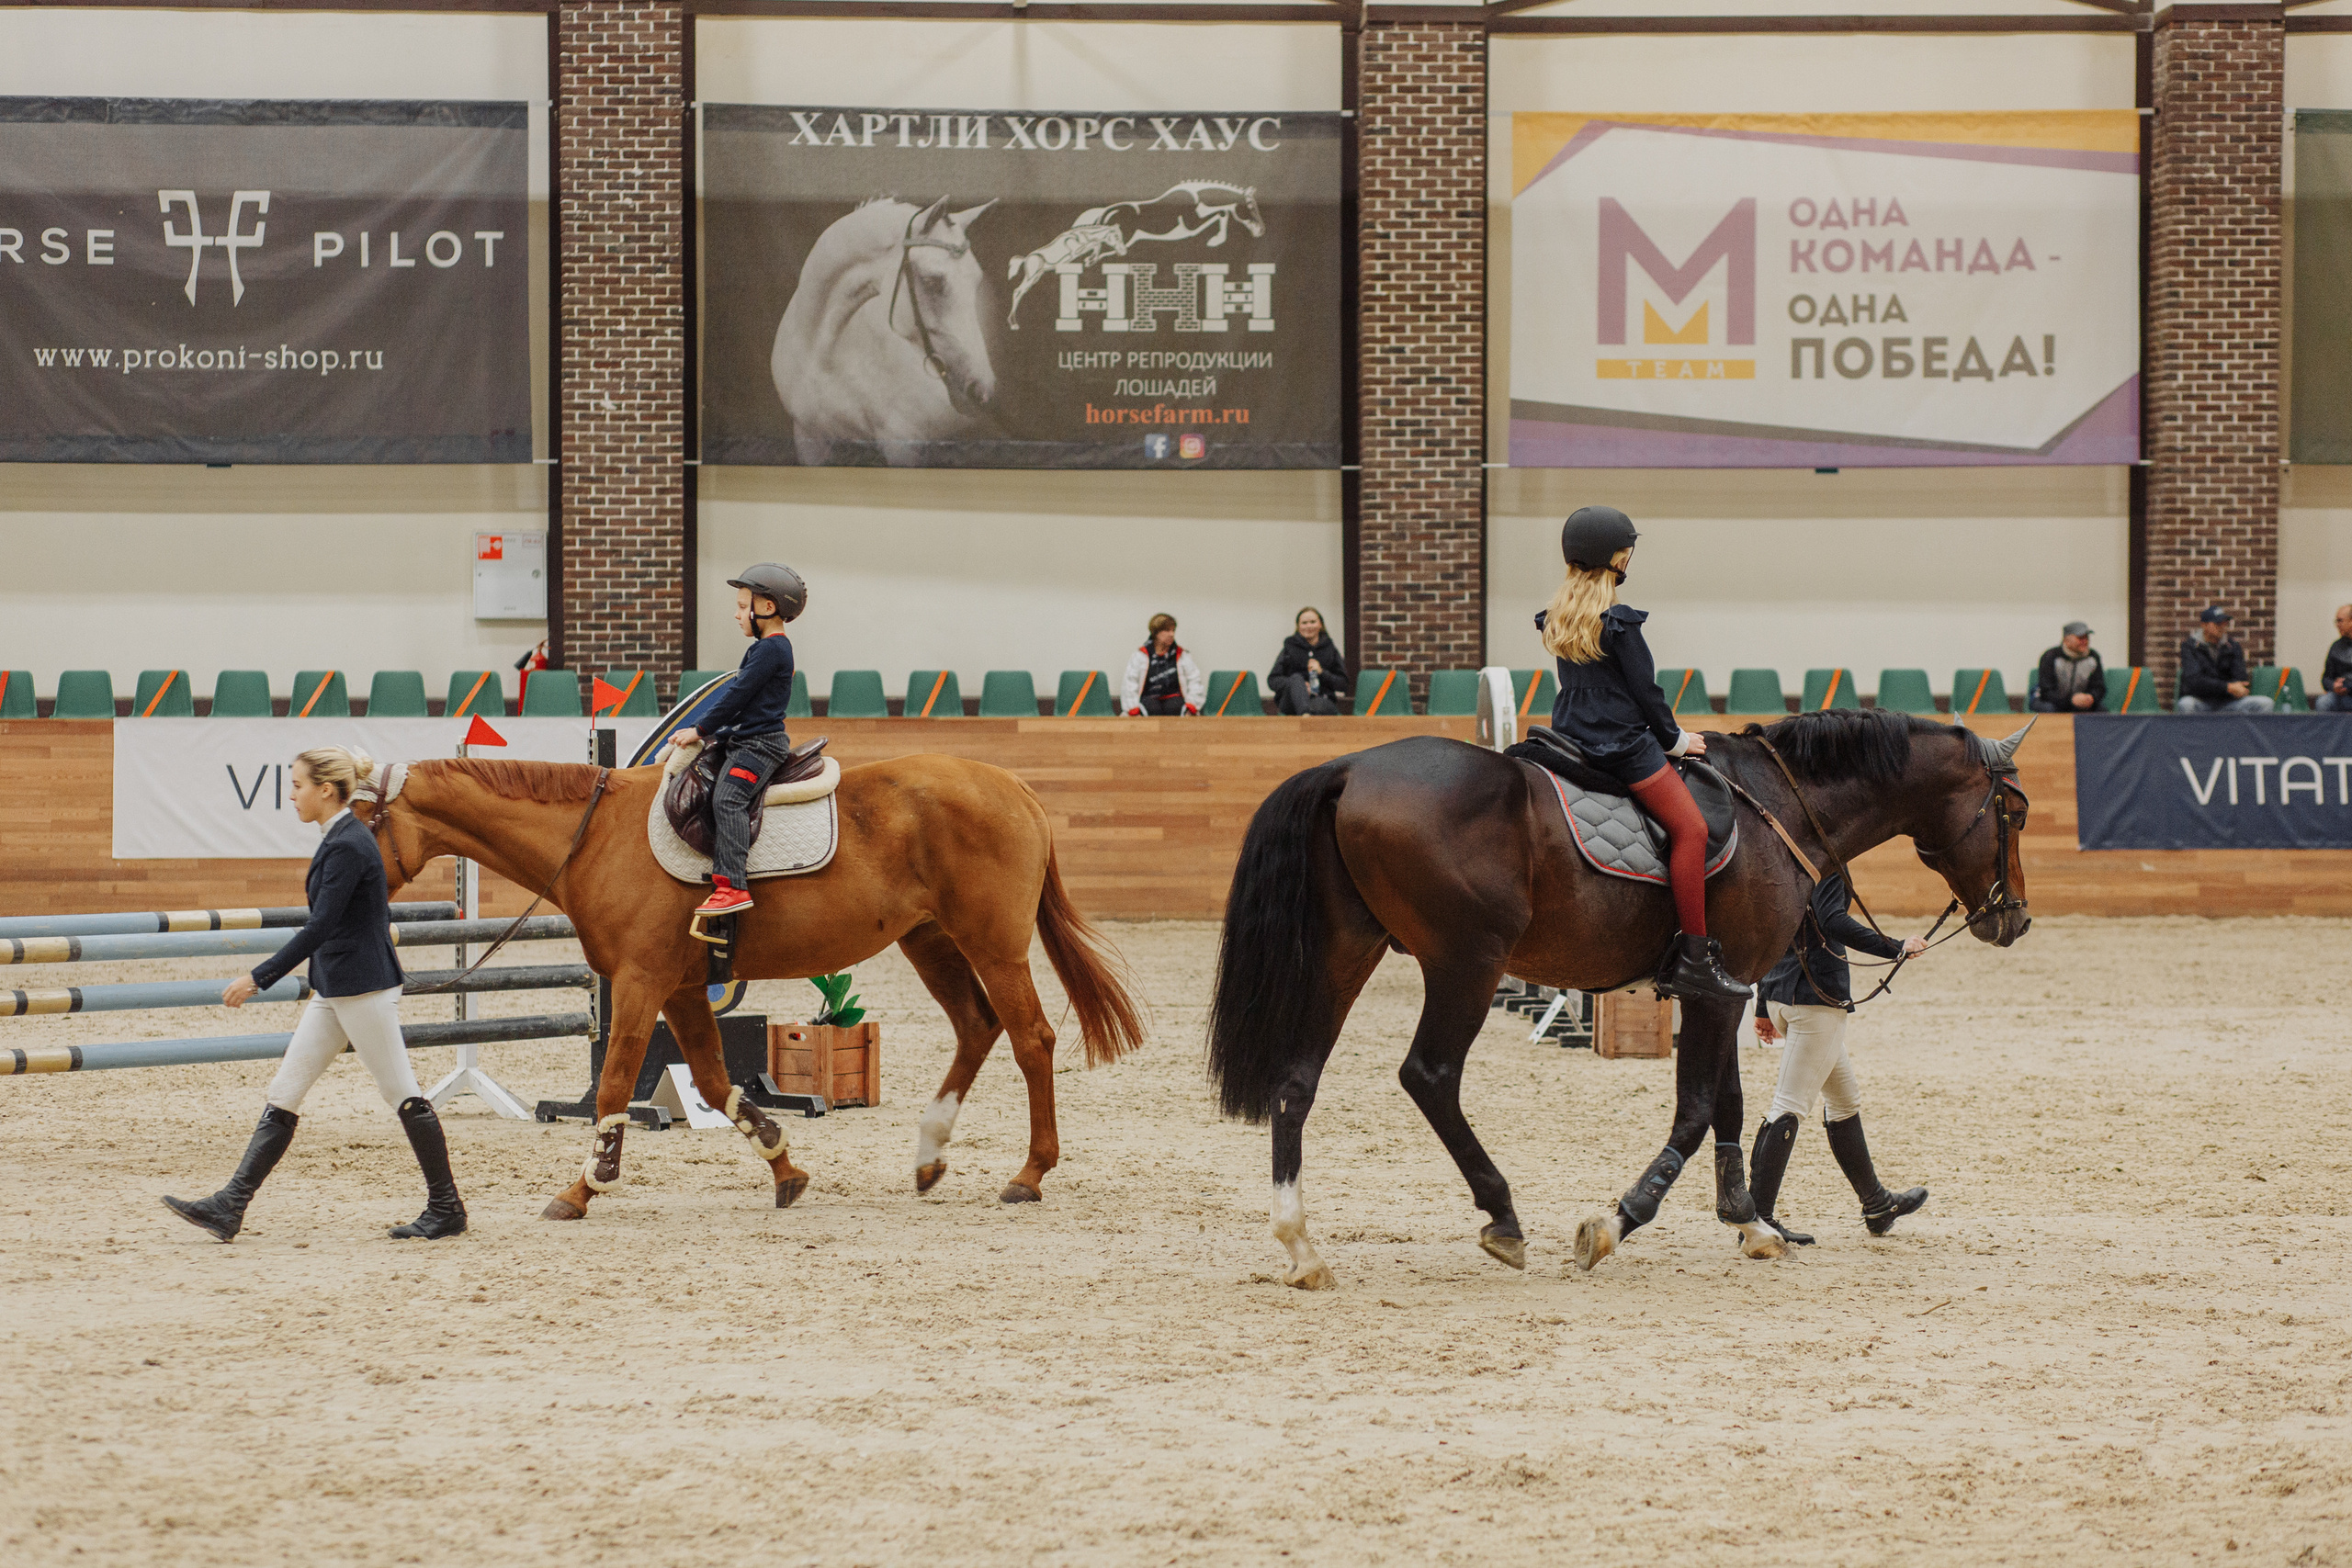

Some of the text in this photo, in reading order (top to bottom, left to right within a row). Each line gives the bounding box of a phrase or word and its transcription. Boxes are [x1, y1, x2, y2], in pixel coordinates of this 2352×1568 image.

[787, 111, 1282, 152] ХАРТЛИ ХОРС ХАУС
[1789, 197, 1909, 231] ОДНА
[313, 230, 504, 268] PILOT
[1790, 237, 2037, 275] КОМАНДА
[1788, 293, 1909, 327] ОДНА
[33, 344, 384, 375] www.prokoni-shop.ru
[1057, 351, 1273, 372] ЦЕНТР РЕПРОДУКЦИИ
[1626, 361, 1725, 378] TEAM
[1791, 333, 2056, 382] ПОБЕДА!
[1113, 375, 1217, 399] ЛОШАДЕЙ
[1085, 402, 1250, 424] horsefarm.ru
[226, 763, 293, 810] VI
[2179, 756, 2352, 806] VITAT
